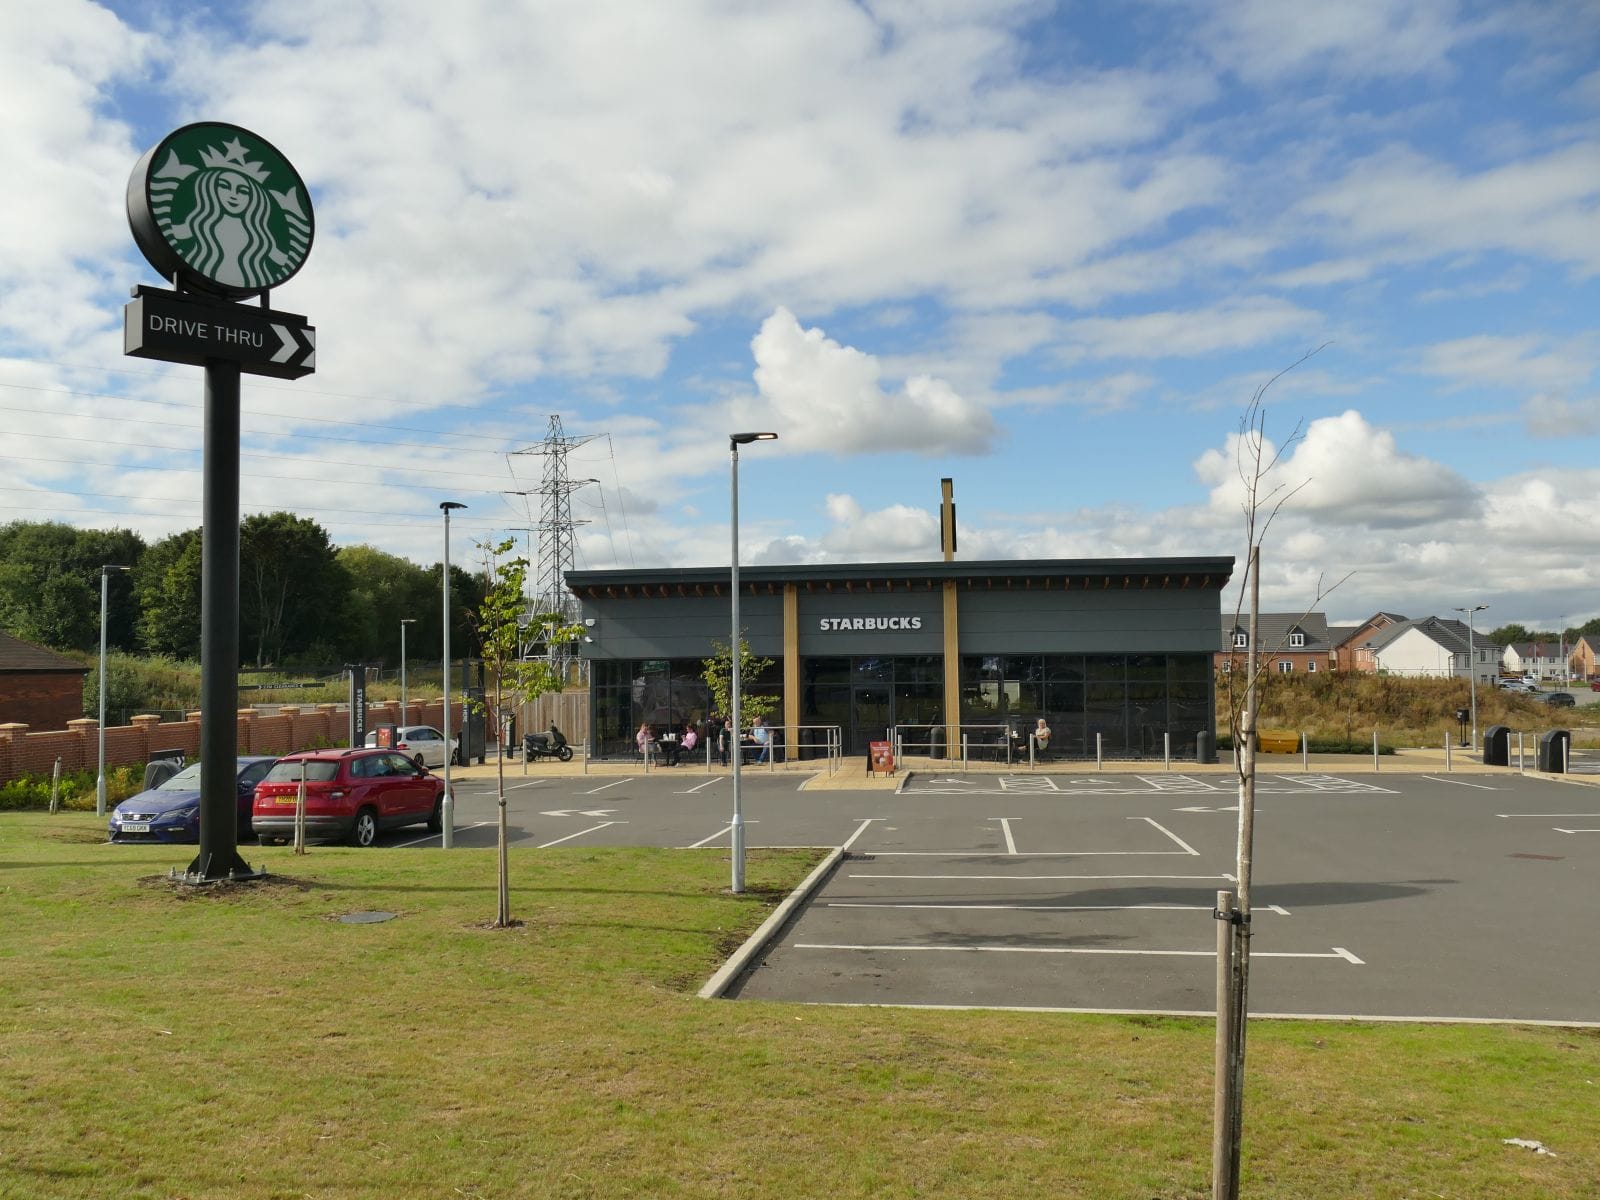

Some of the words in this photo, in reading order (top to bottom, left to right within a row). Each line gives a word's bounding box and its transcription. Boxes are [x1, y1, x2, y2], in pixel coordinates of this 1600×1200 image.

[149, 314, 209, 339] DRIVE
[214, 325, 263, 348] THRU
[820, 616, 922, 631] STARBUCKS
